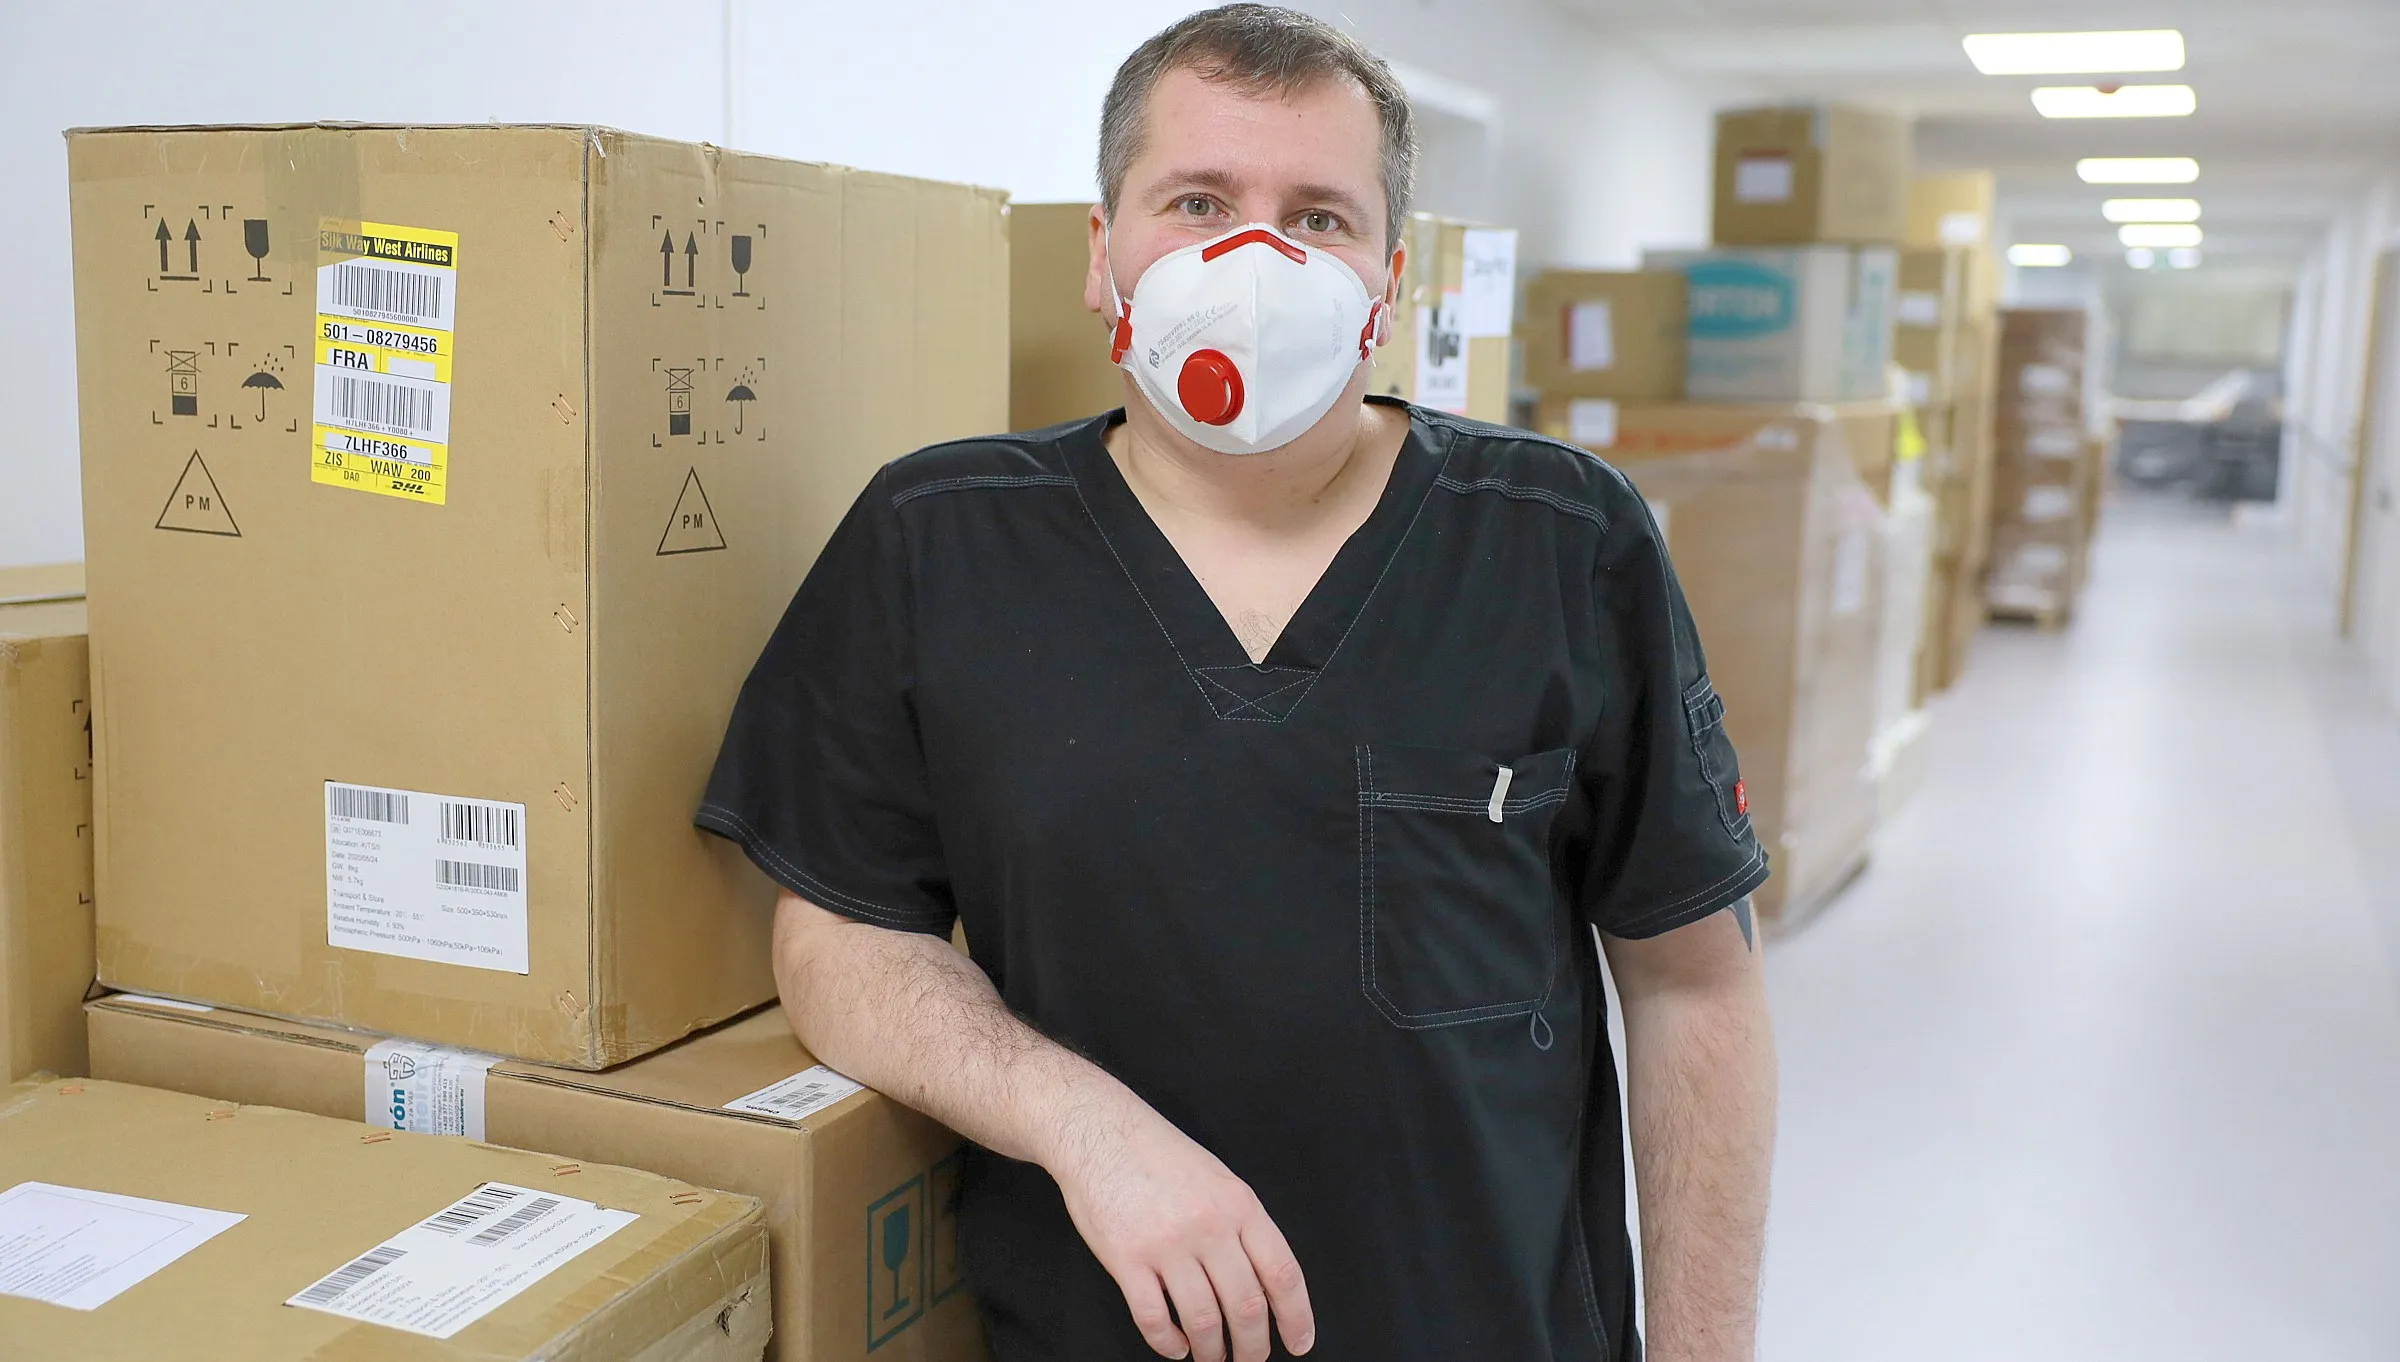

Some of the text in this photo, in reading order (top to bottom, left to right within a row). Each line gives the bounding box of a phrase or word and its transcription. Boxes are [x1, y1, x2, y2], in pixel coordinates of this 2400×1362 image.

[321, 231, 449, 263] Silk Way West Airlines
[323, 322, 349, 340] 501
[366, 328, 437, 353] 08279456
[333, 348, 369, 370] FRA
[180, 377, 188, 391] 6
[676, 395, 684, 409] 6
[344, 436, 408, 459] 7LHF366
[325, 451, 343, 467] ZIS
[371, 459, 403, 478] WAW
[410, 468, 431, 482] 200
[391, 480, 425, 494] DHL
